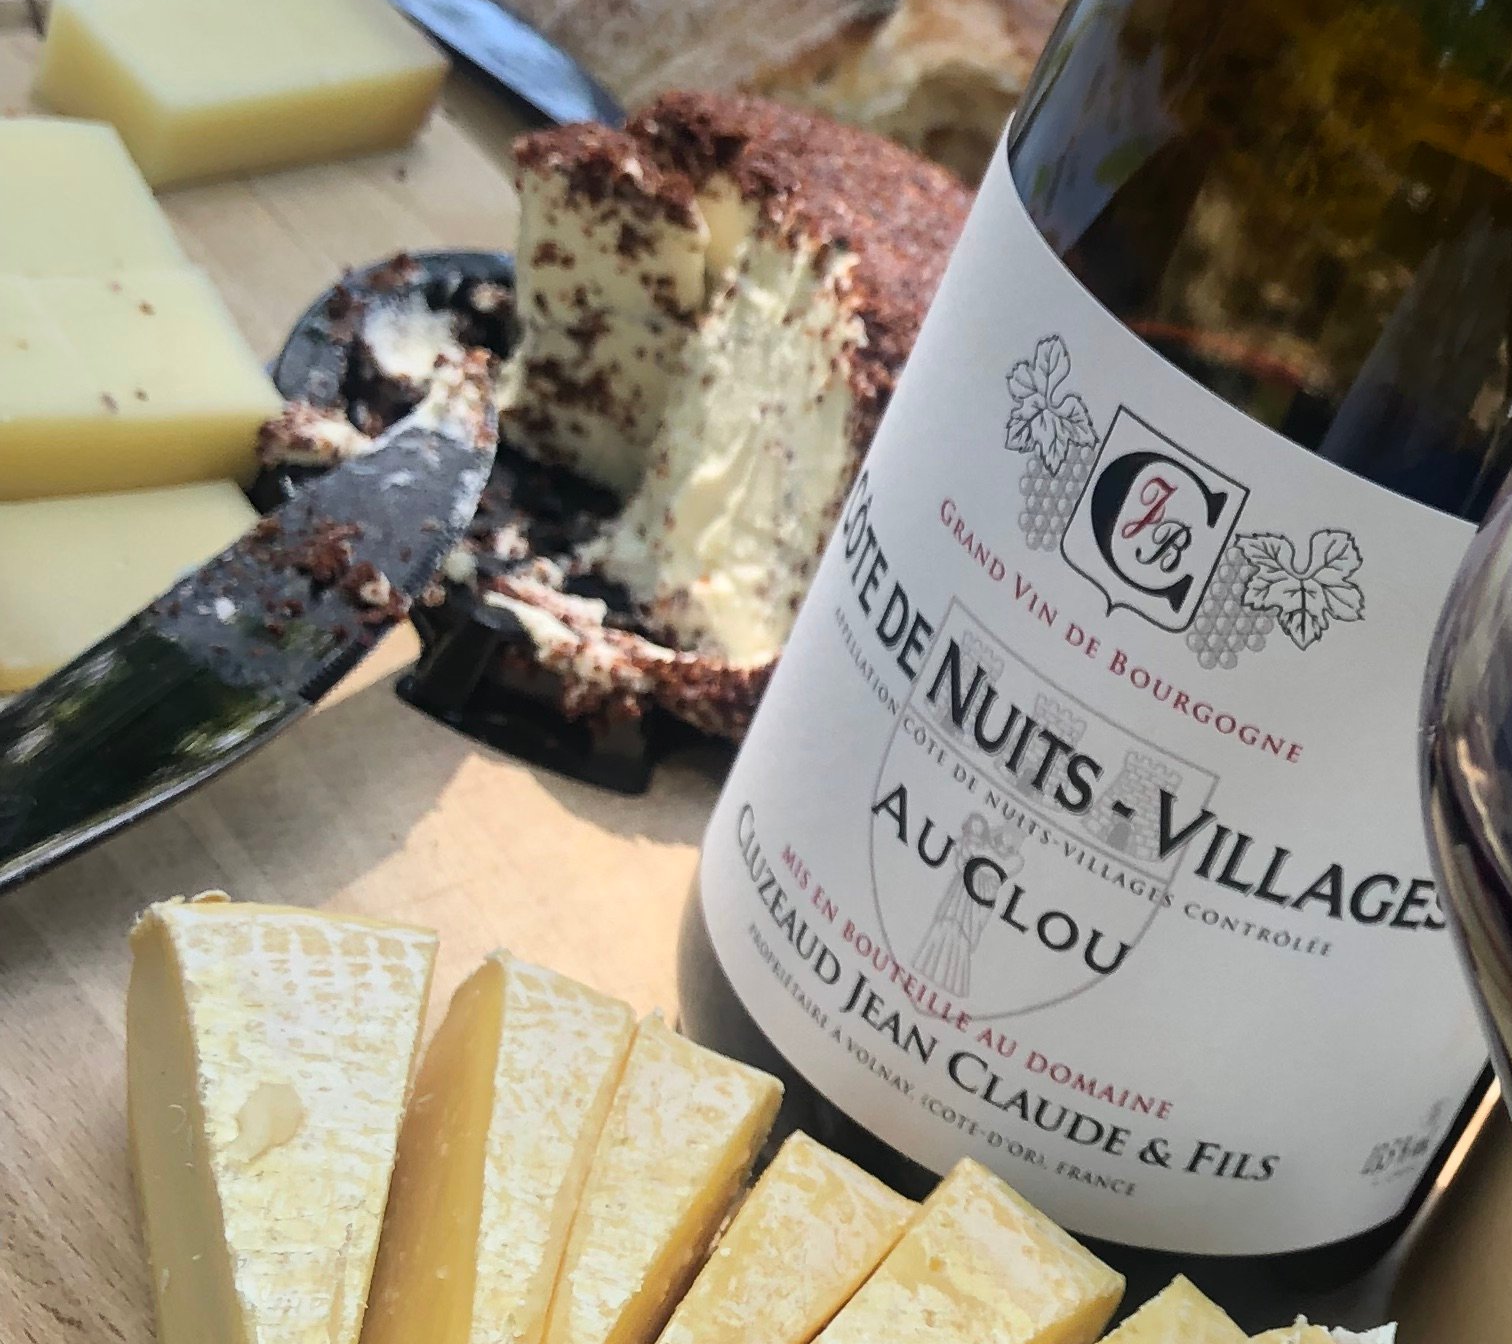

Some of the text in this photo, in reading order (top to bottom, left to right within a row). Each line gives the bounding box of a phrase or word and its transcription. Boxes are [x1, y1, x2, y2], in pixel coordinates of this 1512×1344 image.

[940, 497, 1305, 764] GRAND VIN DE BOURGOGNE
[1090, 450, 1229, 614] C
[875, 580, 935, 682] DE
[925, 637, 1104, 816] NUITS
[870, 783, 1132, 976] AU CLOU
[953, 762, 978, 792] DE
[985, 791, 1175, 908] NUITS-VILLAGES
[780, 843, 1174, 1121] MIS EN BOUTEILLE AU DOMAINE
[839, 970, 939, 1065] JEAN
[947, 1050, 1132, 1157] CLAUDE
[1137, 1136, 1173, 1170] &
[1182, 1139, 1281, 1183] FILS
[1055, 1160, 1138, 1198] FRANCE
